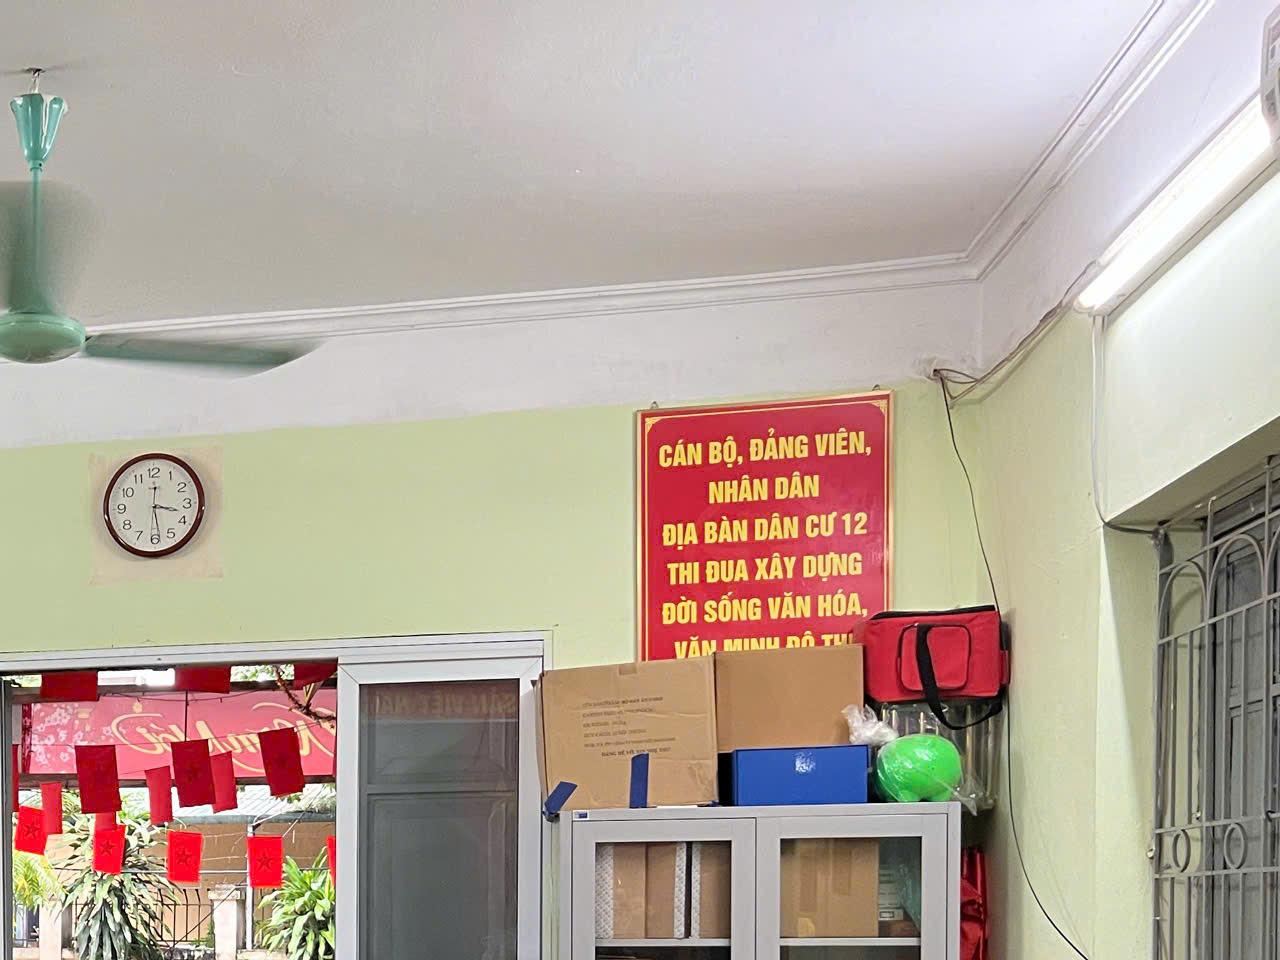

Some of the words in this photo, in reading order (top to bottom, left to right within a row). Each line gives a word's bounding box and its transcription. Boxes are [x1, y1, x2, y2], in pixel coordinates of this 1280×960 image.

[658, 439, 702, 467] CÁN
[709, 436, 743, 468] BỘ,
[750, 427, 808, 462] ĐẢNG
[815, 427, 872, 457] VIÊN,
[147, 467, 160, 478] 12
[134, 474, 143, 484] 11
[122, 487, 134, 498] 10
[177, 482, 187, 493] 2
[708, 474, 768, 504] NHÂN
[775, 471, 820, 500] DÂN
[117, 503, 127, 514] 9
[182, 498, 192, 509] 3
[122, 519, 132, 530] 8
[178, 515, 186, 525] 4
[135, 530, 143, 541] 7
[166, 528, 176, 539] 5
[662, 522, 698, 550] ĐỊA
[704, 516, 748, 544] BÀN
[754, 512, 798, 541] DÂN
[805, 512, 838, 538] CƯ
[841, 512, 868, 536] 12
[150, 533, 161, 545] 6
[667, 561, 700, 585] THI
[705, 558, 749, 583] ĐUA
[754, 552, 797, 580] XÂY
[803, 552, 863, 582] DỰNG
[662, 596, 697, 625] ĐỜI
[704, 592, 762, 623] SỐNG
[767, 592, 811, 619] VĂN
[817, 589, 868, 617] HÓA,
